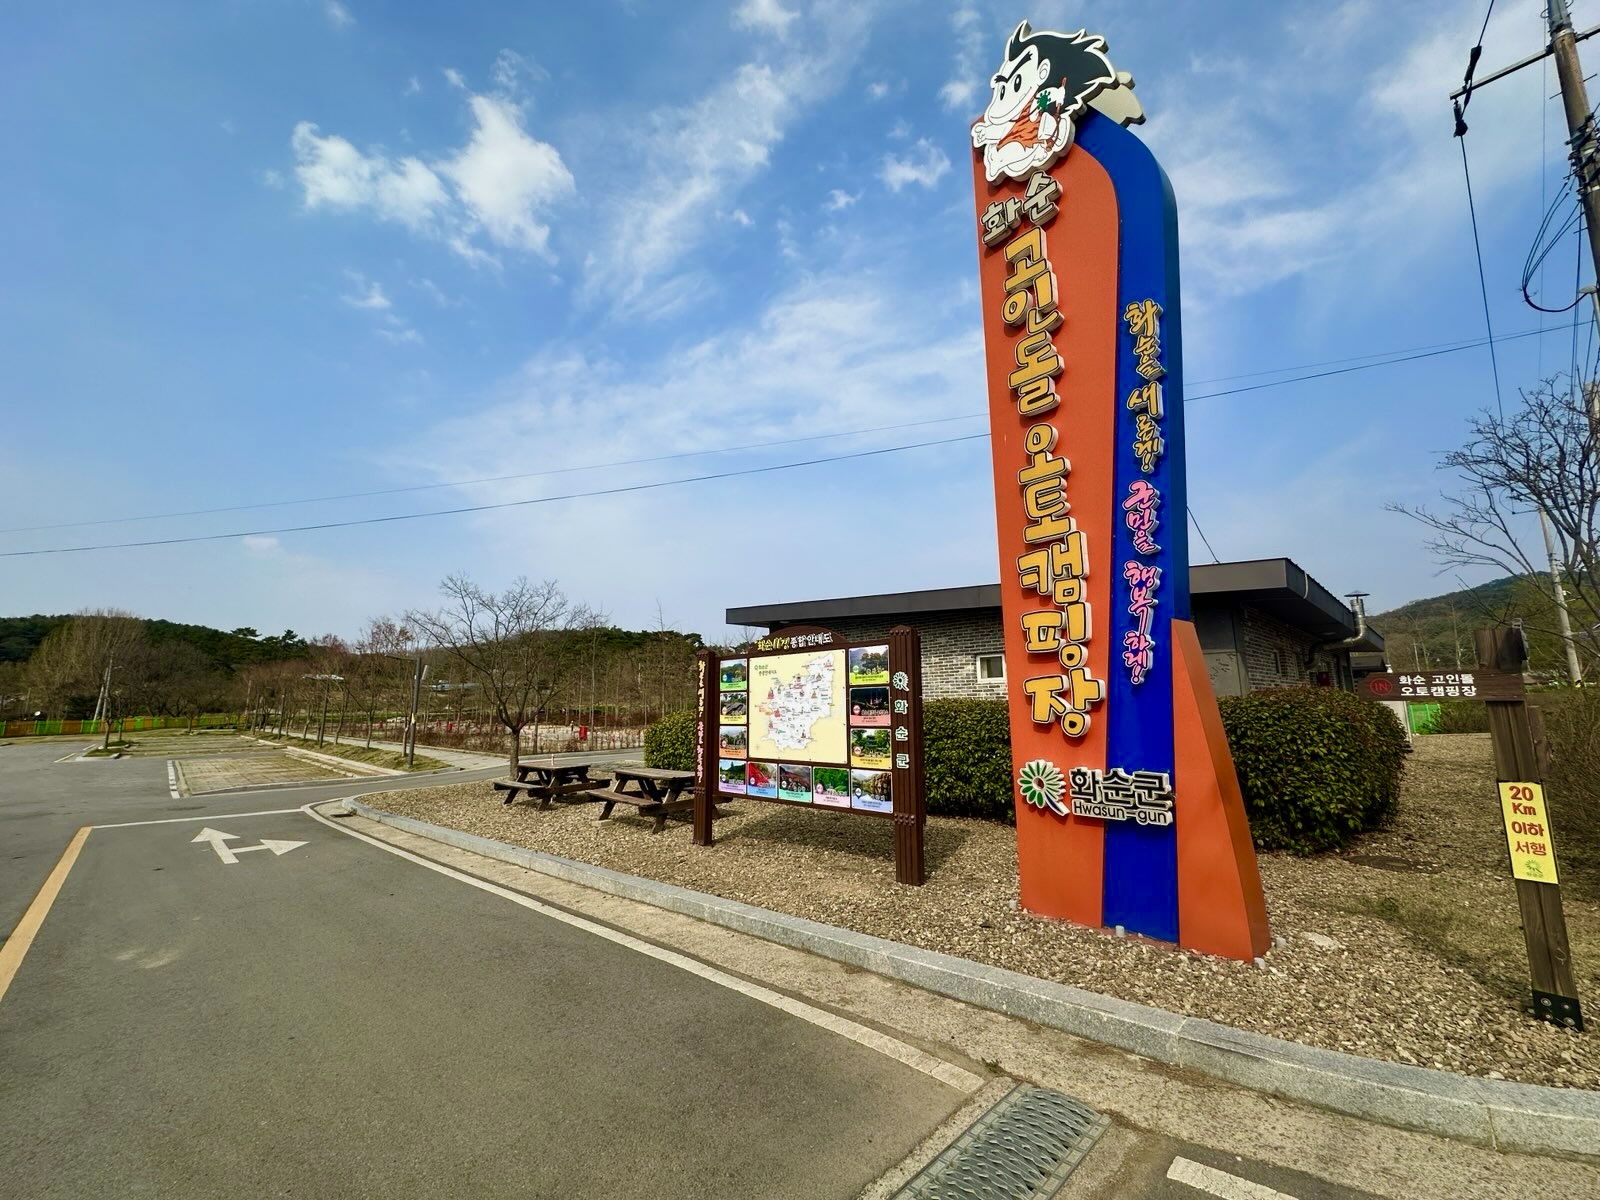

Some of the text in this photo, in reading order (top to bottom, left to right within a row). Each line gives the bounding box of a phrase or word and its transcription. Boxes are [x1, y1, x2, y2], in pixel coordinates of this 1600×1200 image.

[981, 170, 1062, 246] 화순
[1124, 298, 1166, 473] 화순을 새롭게!
[1002, 226, 1104, 737] 고인돌 오토캠핑장
[1122, 479, 1162, 685] 군민을 행복하게!
[1398, 673, 1475, 685] 화순 고인돌
[1401, 685, 1477, 697] 오토캠핑장
[894, 699, 910, 769] 화순군
[1069, 767, 1172, 810] 화순군
[1508, 785, 1534, 801] 20
[1073, 800, 1170, 825] Hwasun-gun
[1512, 802, 1537, 816] Km
[1511, 821, 1544, 837] 이하
[1515, 840, 1547, 856] 서행
